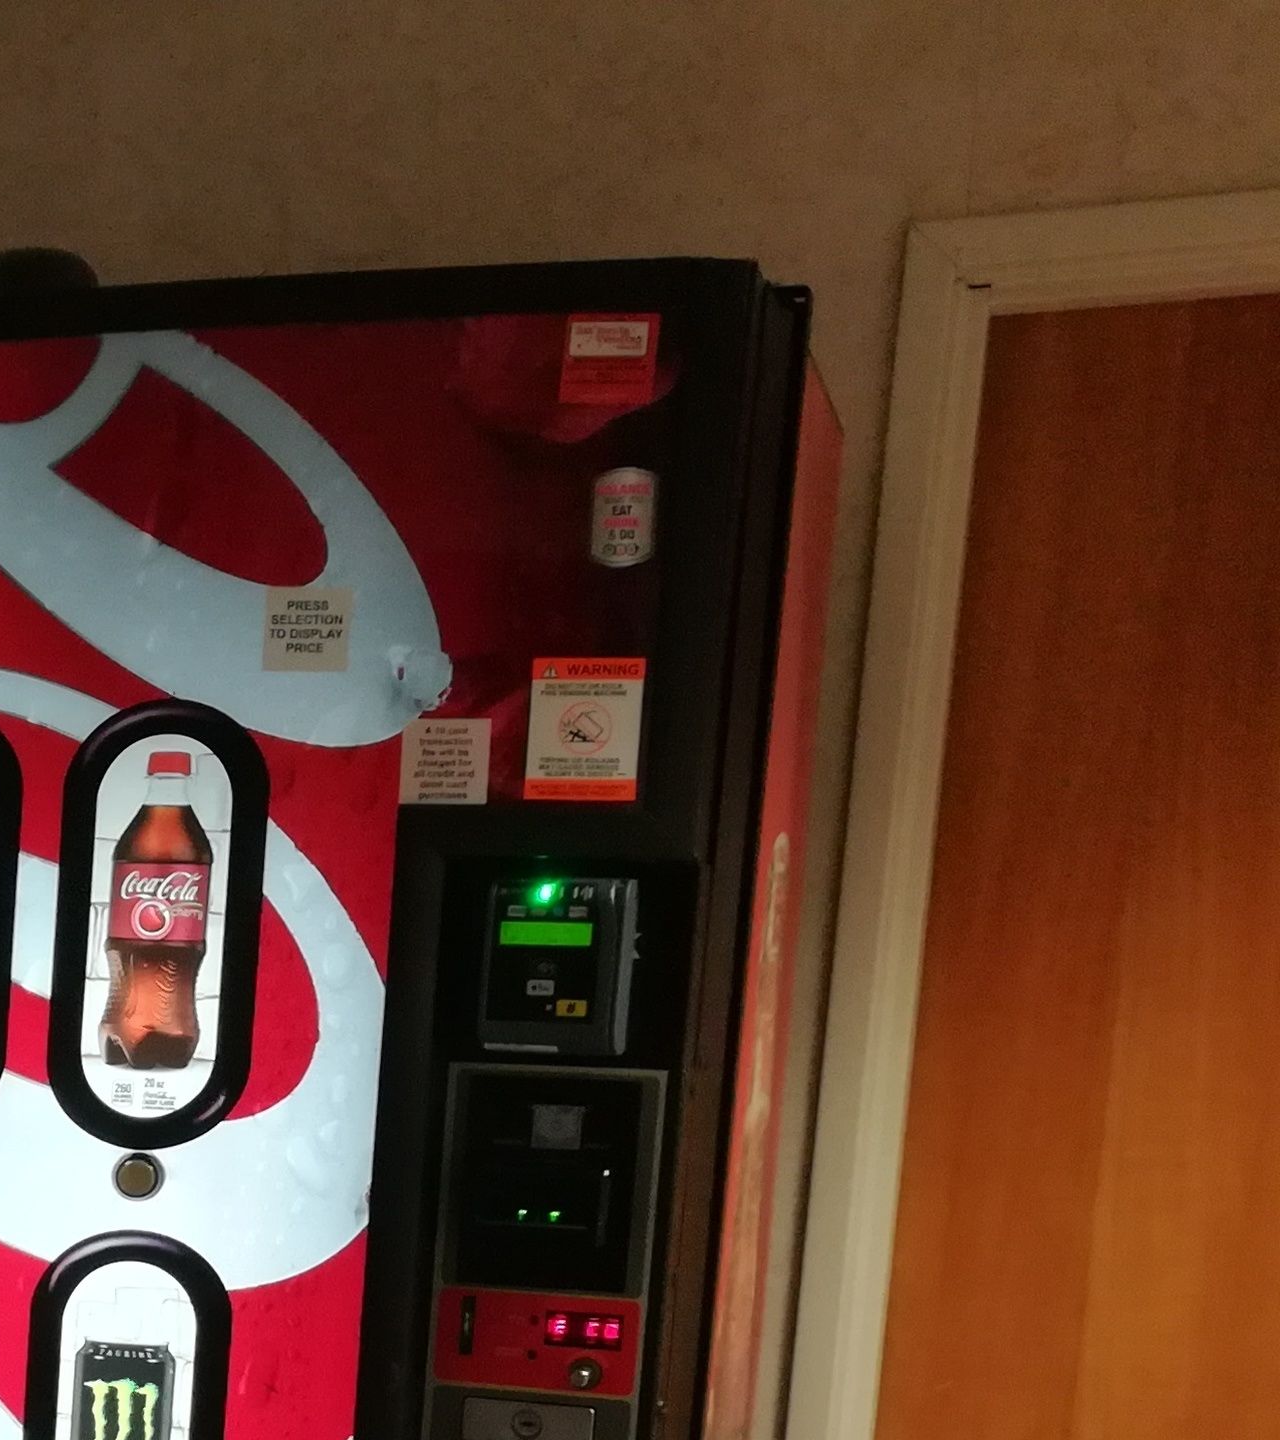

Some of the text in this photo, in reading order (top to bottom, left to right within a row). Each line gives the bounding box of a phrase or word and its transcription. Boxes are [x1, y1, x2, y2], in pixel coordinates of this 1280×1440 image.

[612, 505, 632, 515] EAT
[287, 600, 329, 611] PRESS
[271, 614, 343, 625] SELECTION
[270, 629, 343, 639] TO DISPLAY
[286, 643, 324, 653] PRICE
[566, 663, 640, 675] WARNING
[121, 871, 202, 900] Coca-Cola
[144, 1078, 155, 1087] 20
